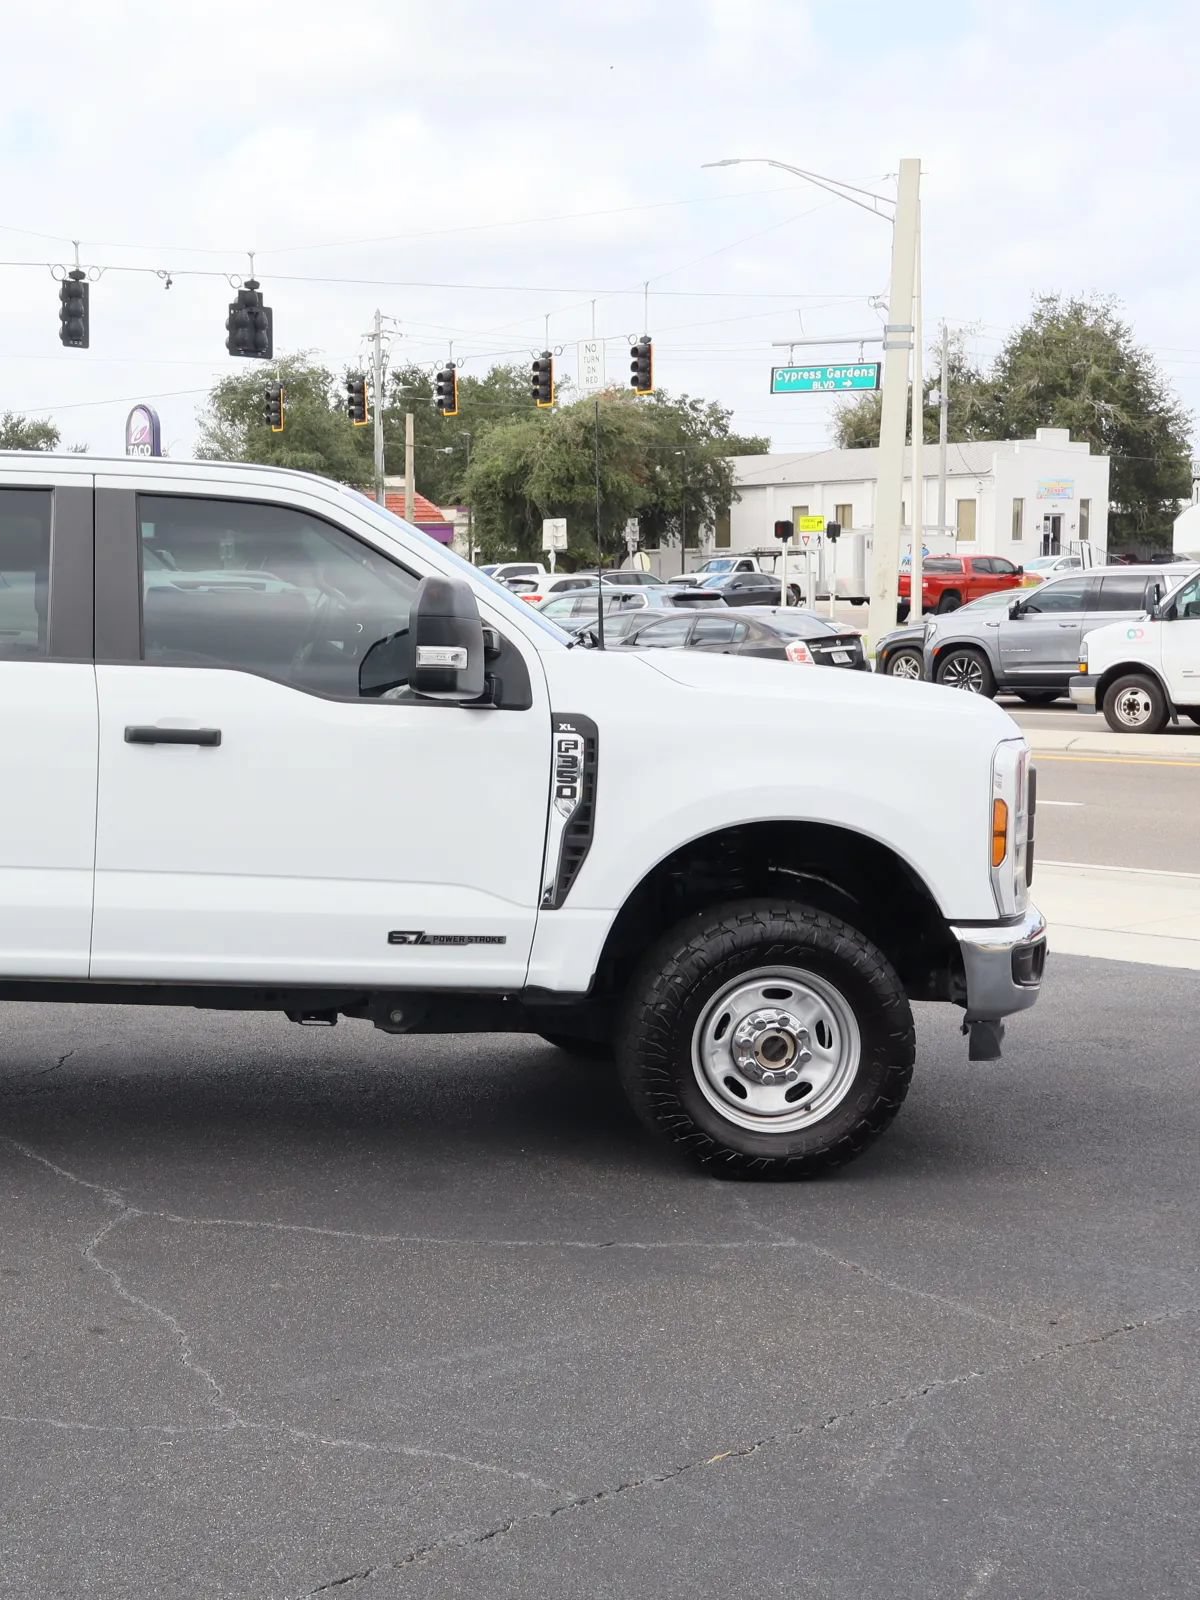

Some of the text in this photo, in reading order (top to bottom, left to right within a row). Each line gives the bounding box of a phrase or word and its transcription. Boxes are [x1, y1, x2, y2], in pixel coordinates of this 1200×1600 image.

[584, 343, 597, 353] NO
[583, 355, 600, 364] TURN
[587, 366, 596, 374] ON
[775, 367, 875, 383] Cypress Gardens
[585, 375, 599, 385] RED
[812, 380, 836, 390] BLVD
[128, 444, 152, 457] TACO
[558, 723, 577, 732] XL
[556, 739, 579, 799] F350
[387, 930, 504, 945] 6.7L POWER STROKE
